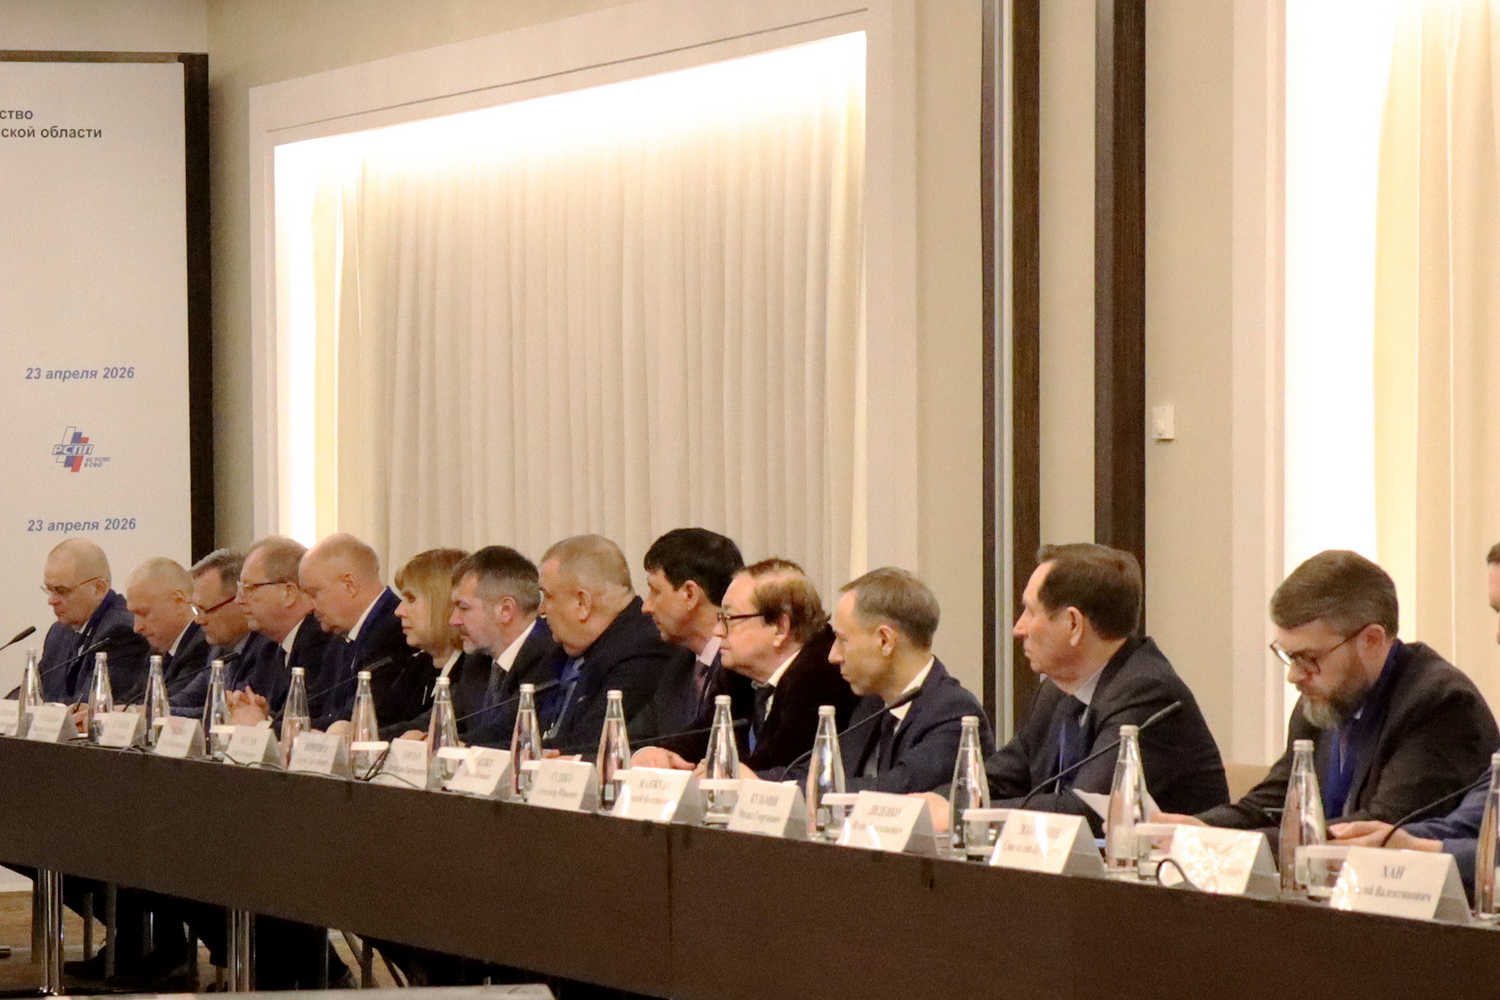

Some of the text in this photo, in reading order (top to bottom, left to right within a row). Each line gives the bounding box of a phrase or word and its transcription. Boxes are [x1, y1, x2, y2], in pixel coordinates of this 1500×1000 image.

[40, 125, 103, 139] области
[25, 366, 135, 383] 23 апреля 2026
[52, 444, 94, 455] РСПП
[27, 517, 136, 534] 23 апреля 2026
